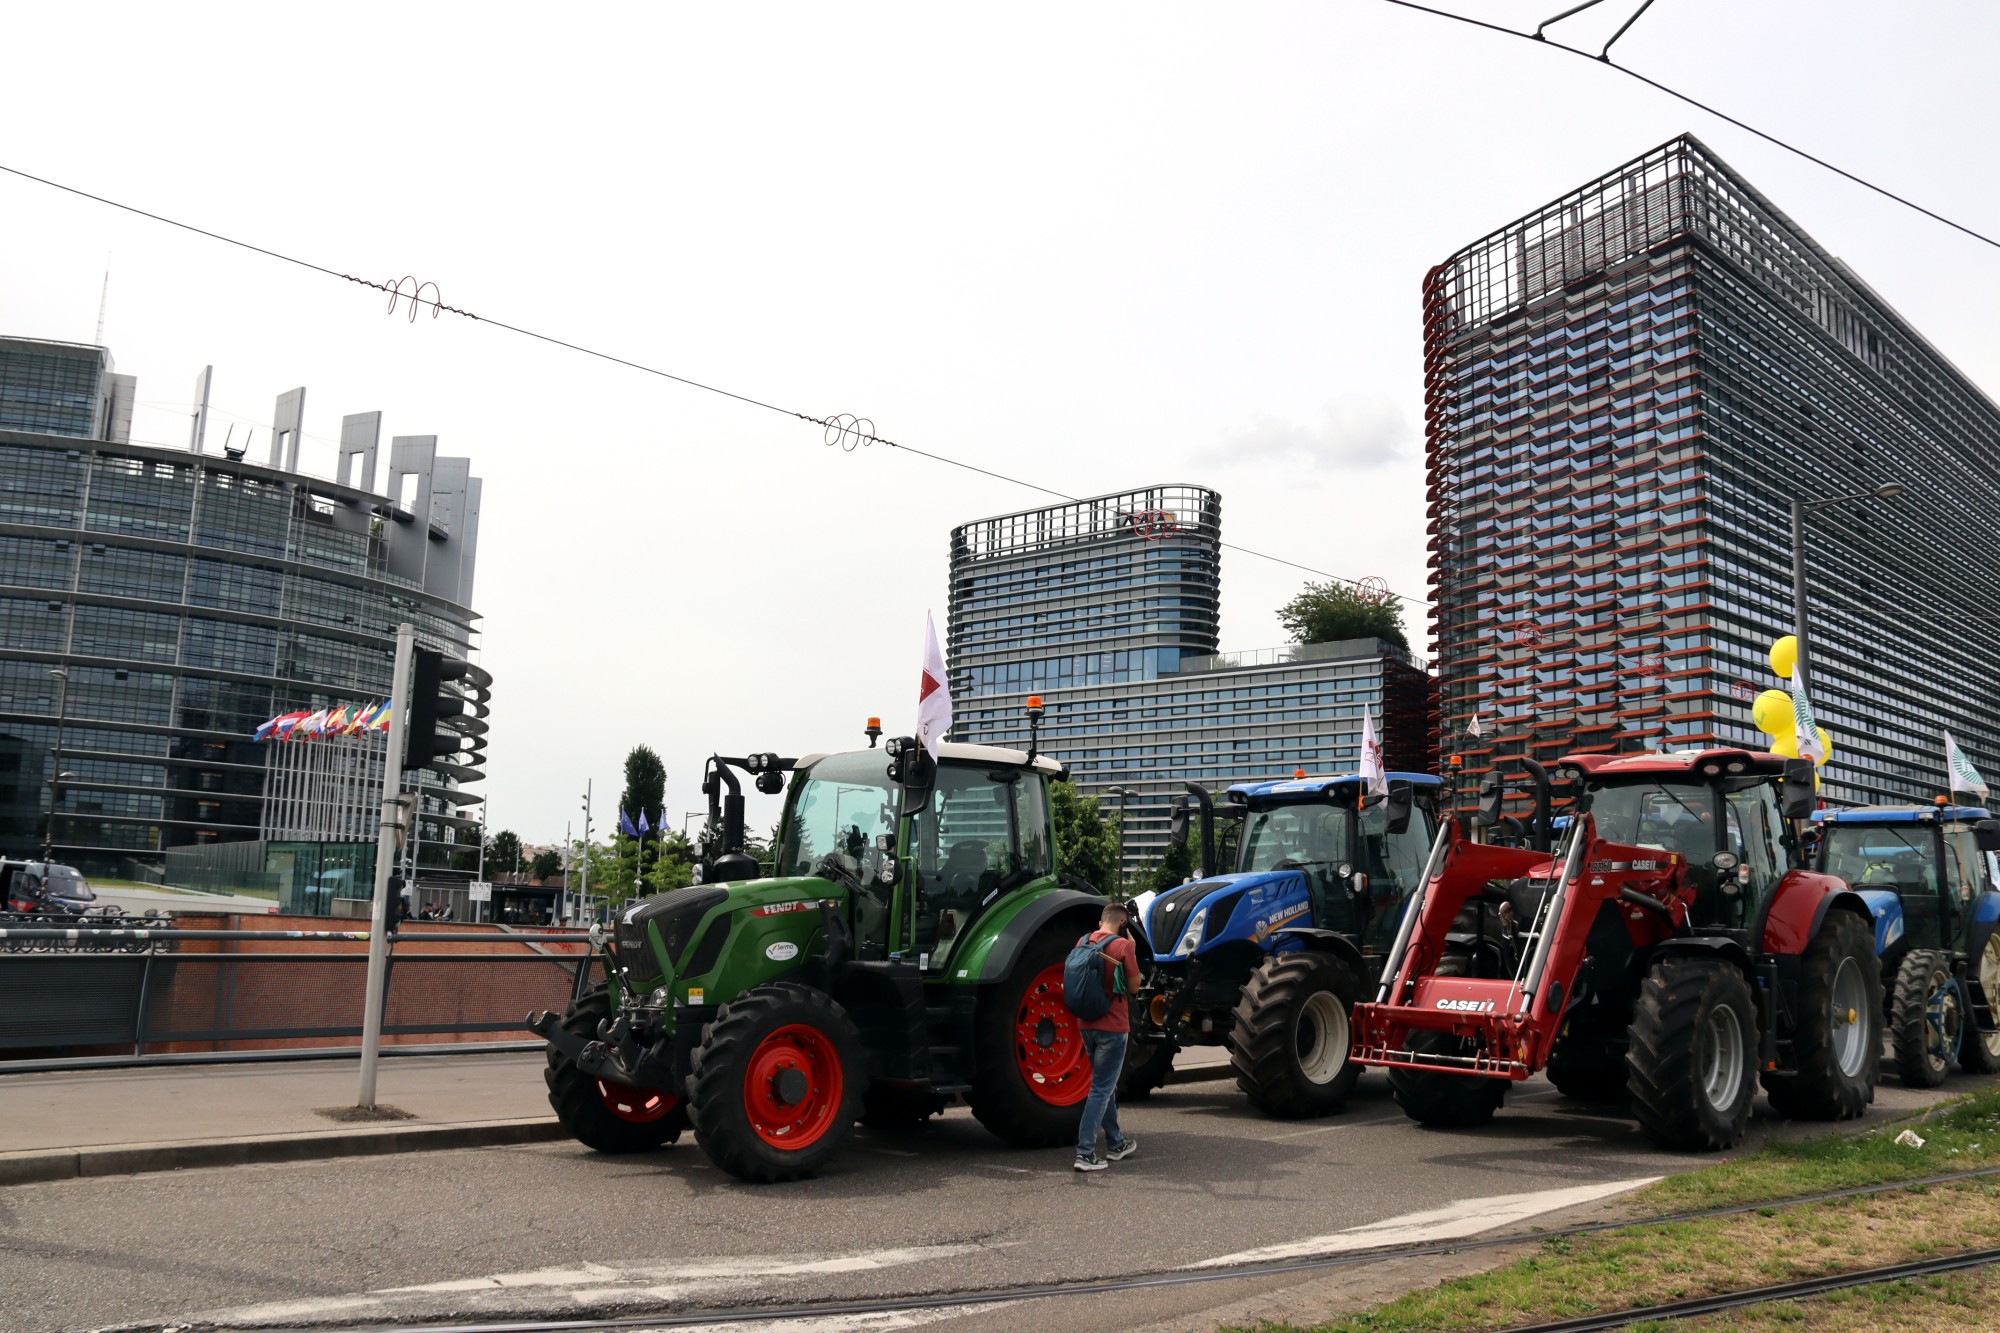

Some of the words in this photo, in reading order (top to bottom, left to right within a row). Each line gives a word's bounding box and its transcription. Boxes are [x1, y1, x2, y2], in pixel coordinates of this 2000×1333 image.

[1632, 860, 1649, 870] CASE
[763, 901, 798, 914] FENDT
[1269, 911, 1284, 924] NEW
[1284, 901, 1308, 917] HOLLAND
[1436, 999, 1479, 1011] CASE
